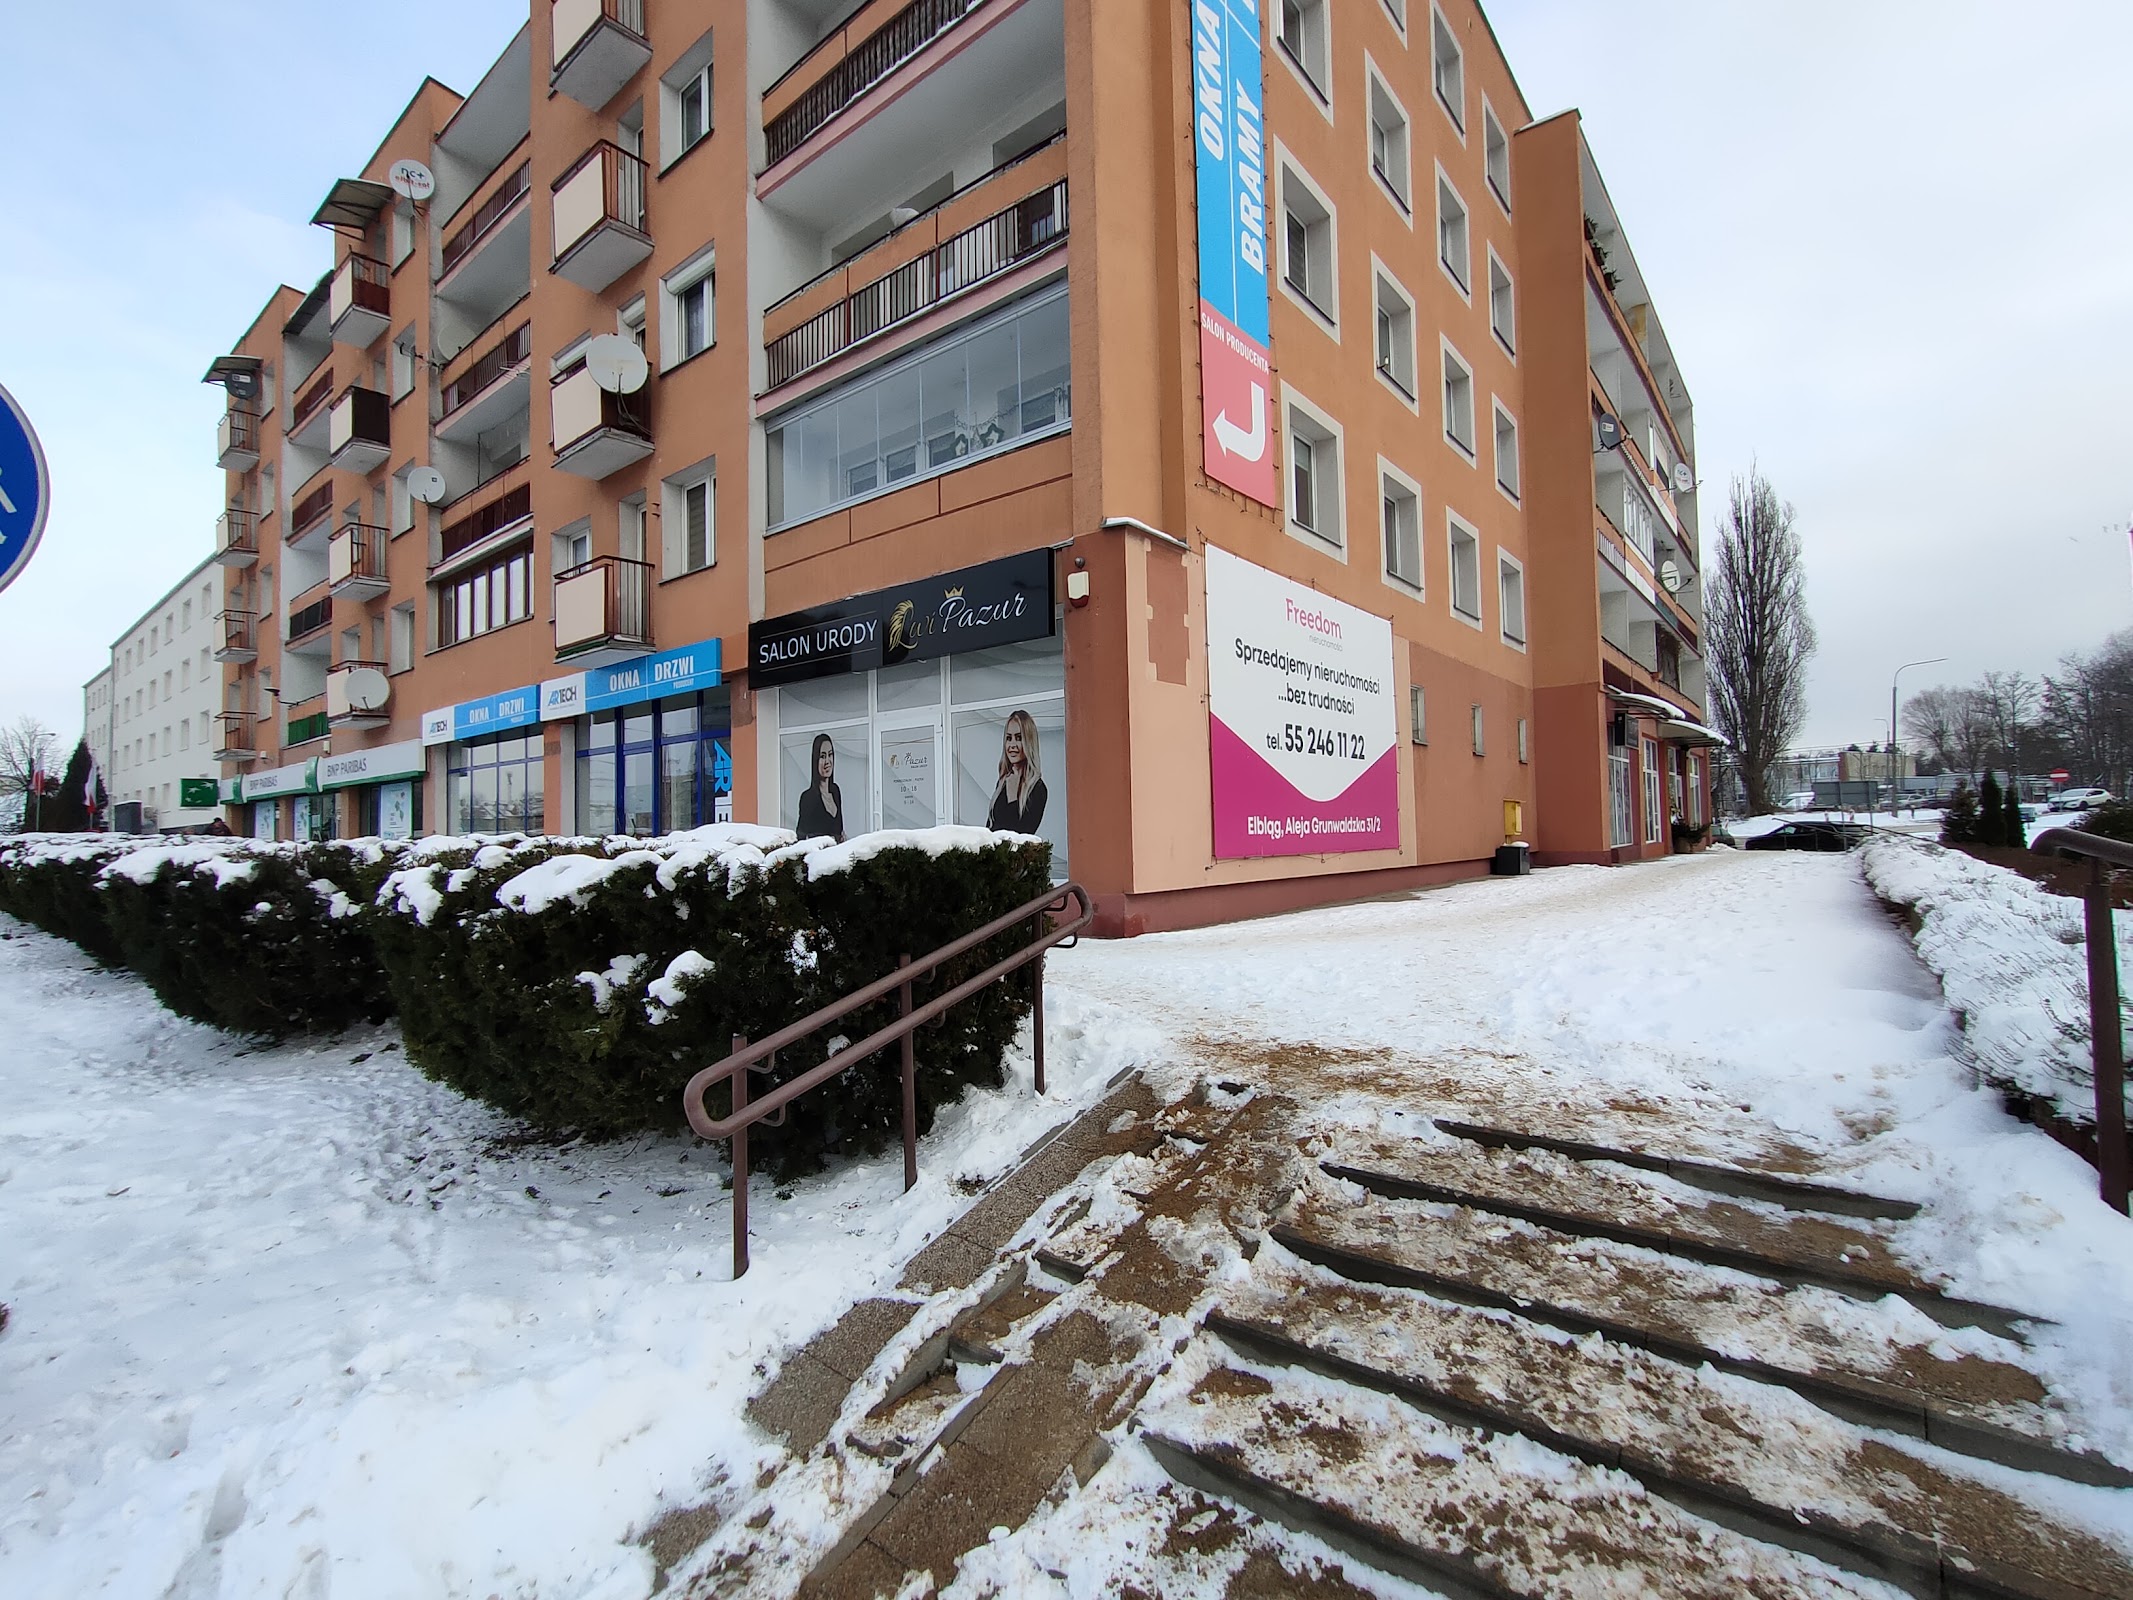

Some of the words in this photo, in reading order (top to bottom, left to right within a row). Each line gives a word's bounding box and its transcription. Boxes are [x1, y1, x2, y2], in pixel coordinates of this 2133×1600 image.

[1196, 0, 1224, 161] OKNA
[401, 167, 425, 180] nc+
[1236, 77, 1264, 275] BRAMY
[1201, 312, 1225, 343] SALON
[1226, 330, 1269, 376] PRODUCENTA
[938, 592, 1028, 633] Pazur
[1285, 598, 1342, 639] Freedom
[759, 634, 810, 664] SALON
[816, 619, 878, 652] URODY
[609, 669, 640, 692] OKNA
[654, 655, 694, 682] DRZWI
[1235, 637, 1312, 682] Sprzedajemy
[1314, 662, 1380, 695] nieruchomości
[469, 706, 490, 724] OKNA
[498, 697, 525, 717] DRZWI
[547, 685, 577, 707] ARTECH
[1308, 690, 1355, 716] trudności
[1266, 732, 1283, 751] tel.
[1285, 723, 1304, 753] 55
[1307, 727, 1335, 757] 246
[1337, 731, 1347, 758] 11
[1350, 734, 1366, 760] 22
[327, 763, 340, 778] BNP
[341, 758, 367, 776] PARIBAS
[1247, 816, 1284, 840] Elbląg,
[1285, 816, 1311, 839] Aleja
[1311, 816, 1366, 835] Grunwaldzka
[1366, 815, 1382, 833] 31/2
